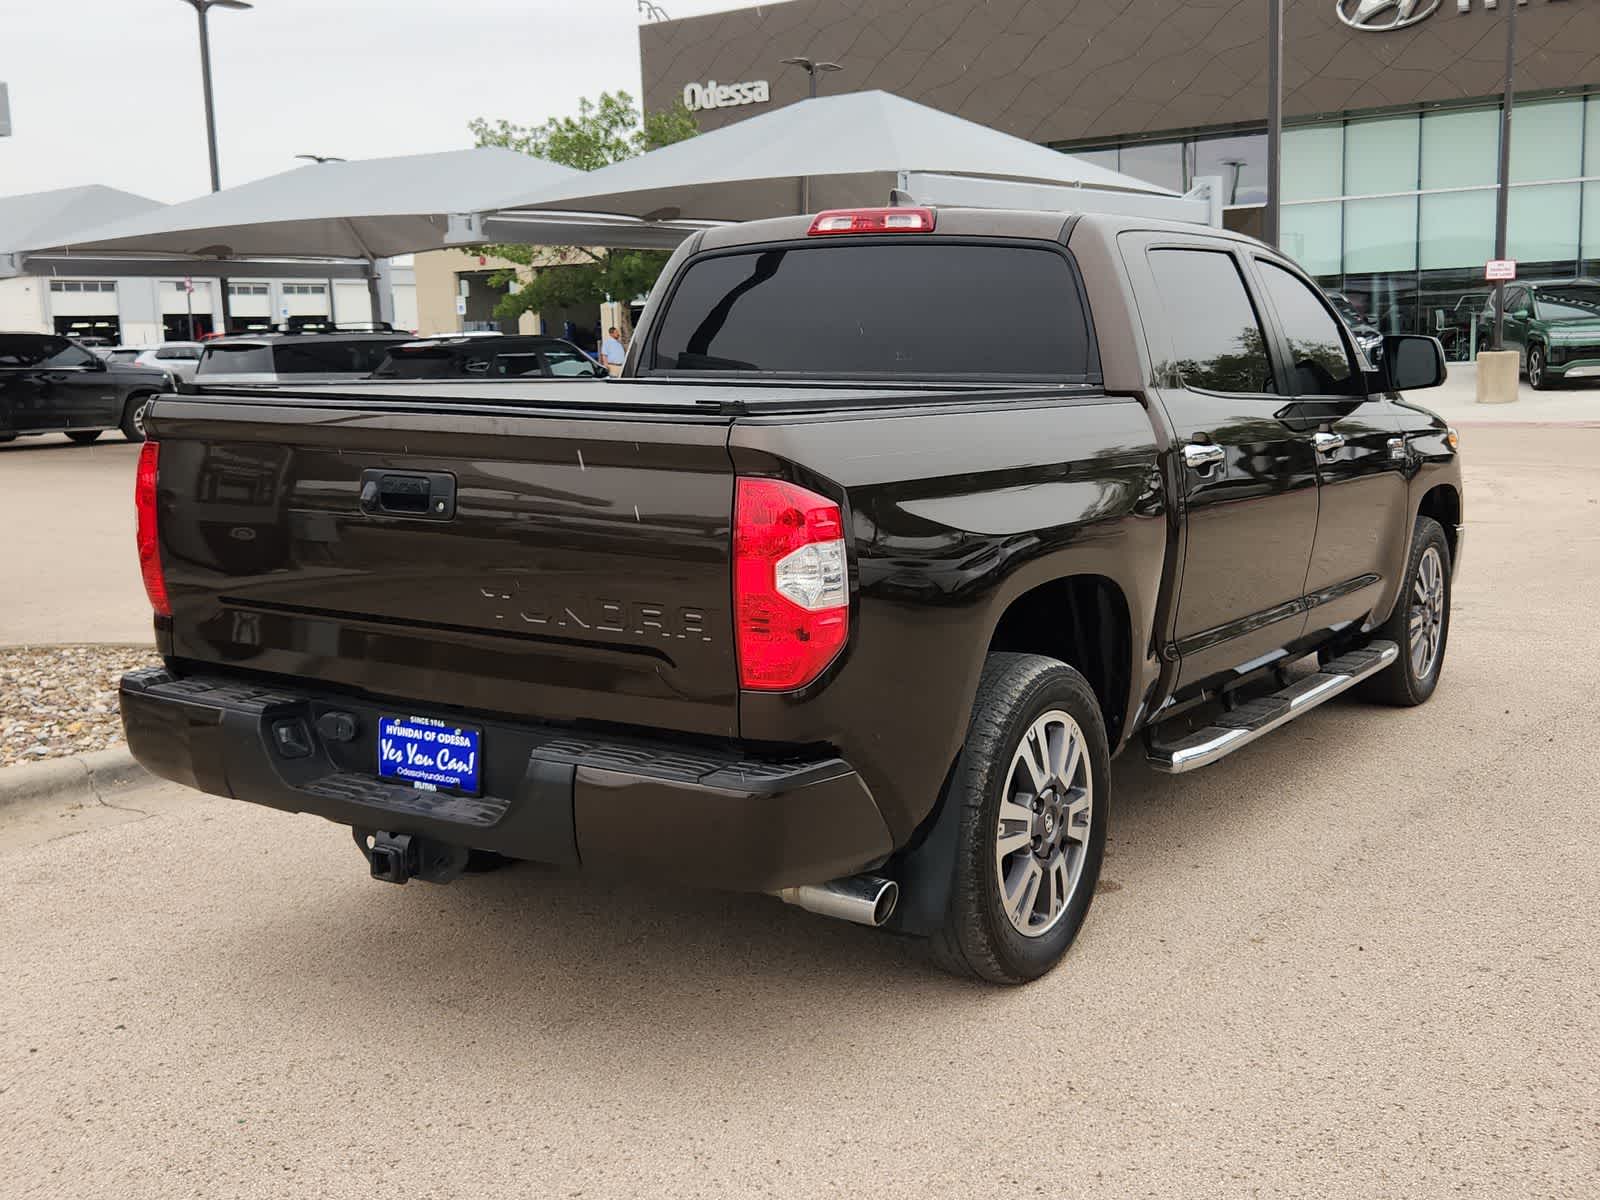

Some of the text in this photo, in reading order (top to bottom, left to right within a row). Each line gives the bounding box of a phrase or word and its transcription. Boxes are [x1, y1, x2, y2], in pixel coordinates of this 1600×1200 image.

[683, 80, 769, 111] Odessa
[481, 585, 712, 641] TUNDRA
[410, 716, 430, 726] SINCE
[386, 725, 471, 748] HYUNDAI OF ODESSA
[381, 739, 475, 774] Yes You Can!
[397, 766, 460, 784] OdessaHyundai.com
